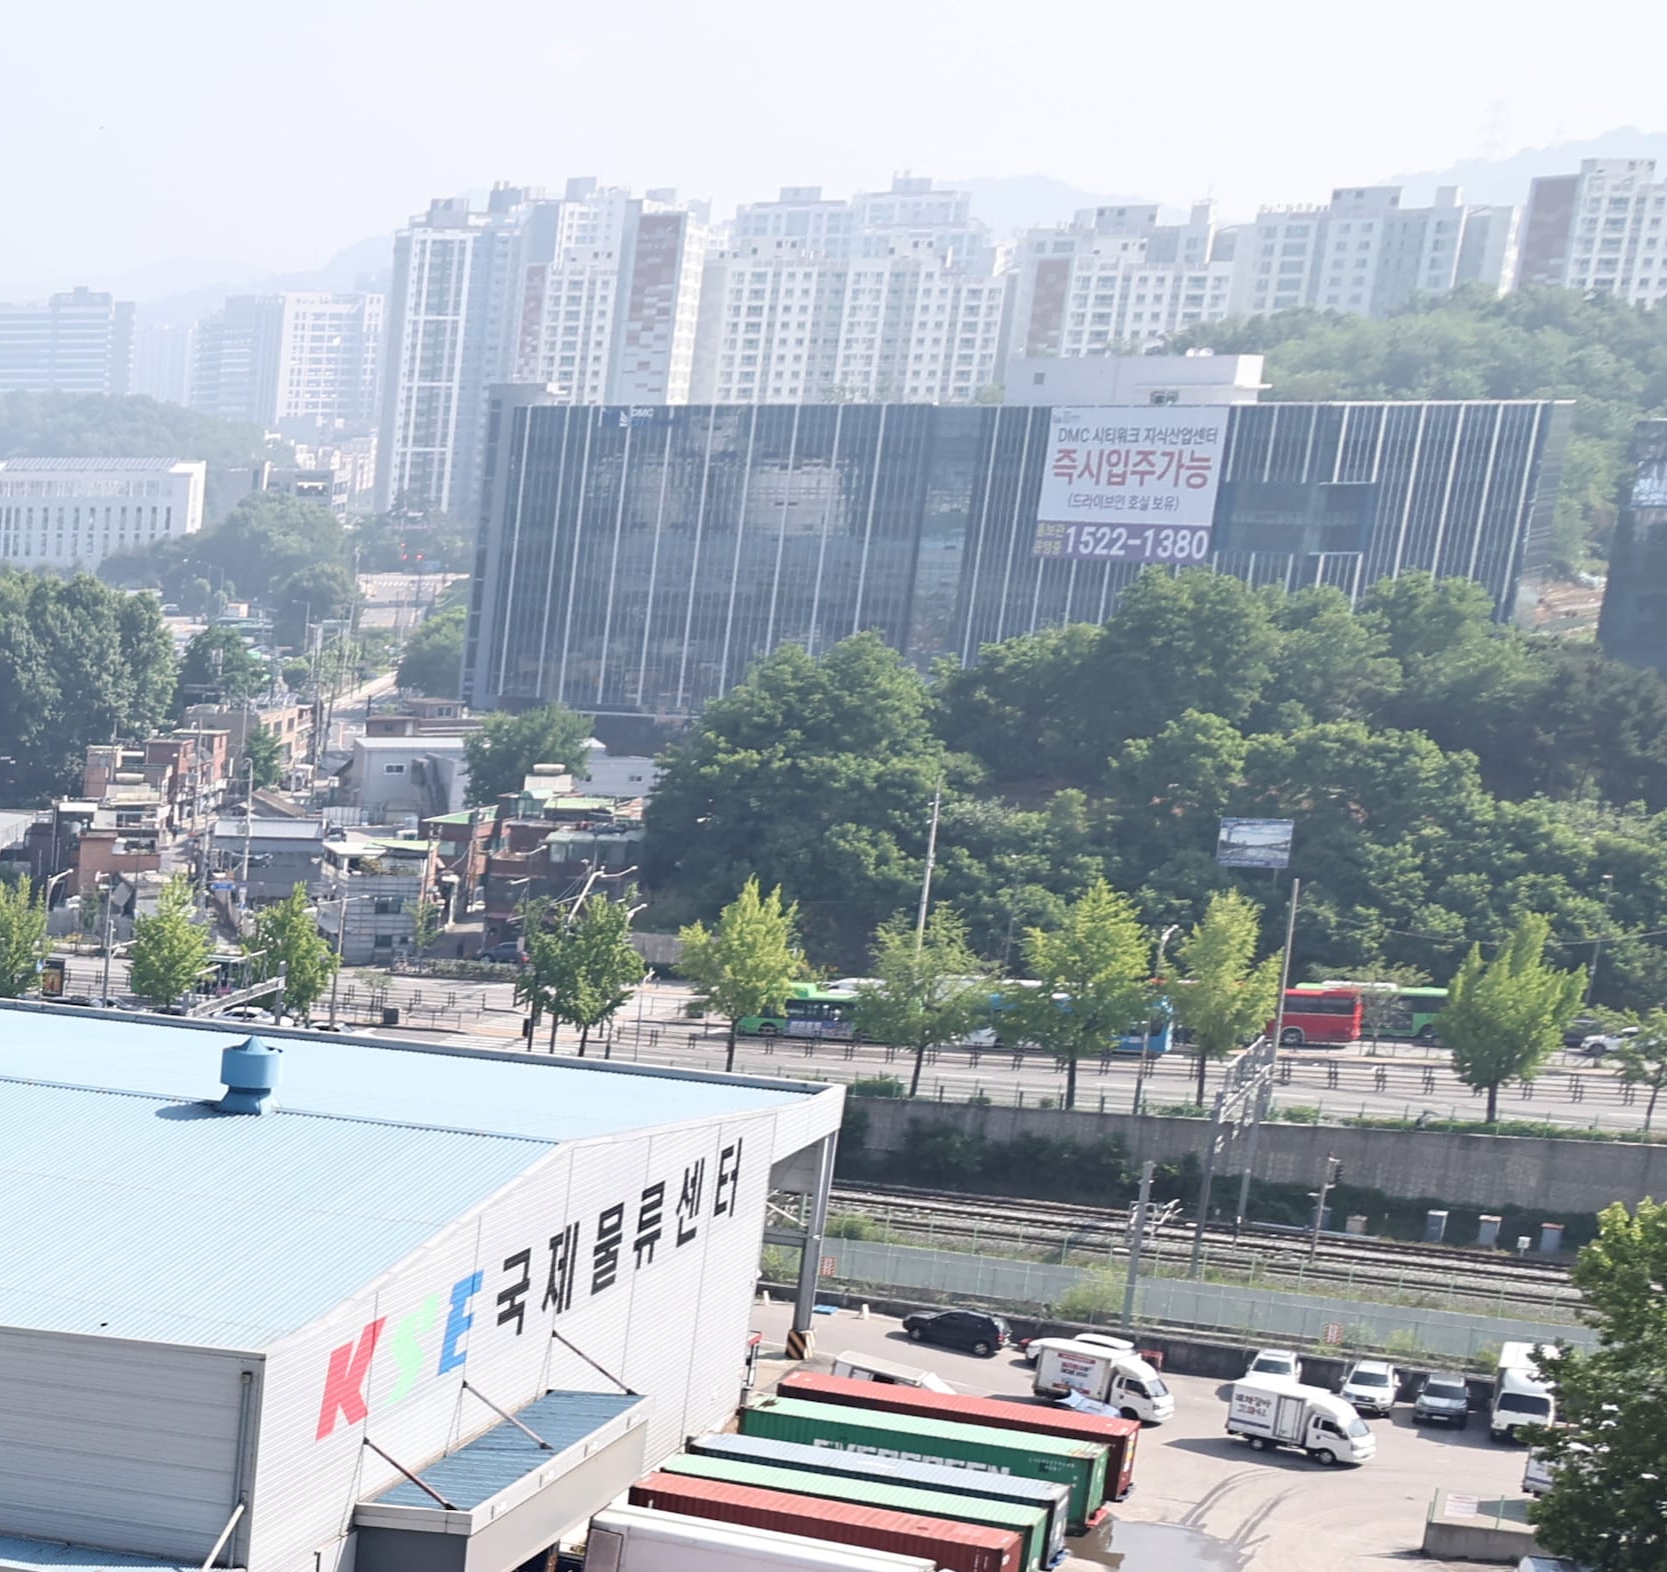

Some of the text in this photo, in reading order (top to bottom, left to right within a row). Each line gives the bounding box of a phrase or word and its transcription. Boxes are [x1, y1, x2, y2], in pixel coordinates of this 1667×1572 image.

[1058, 427, 1218, 445] DMC 시티워크 지식산업센터
[1052, 448, 1212, 490] 즉시입주가능
[1067, 525, 1209, 560] 1522-1380
[316, 1137, 743, 1442] KSE 국제물류센터
